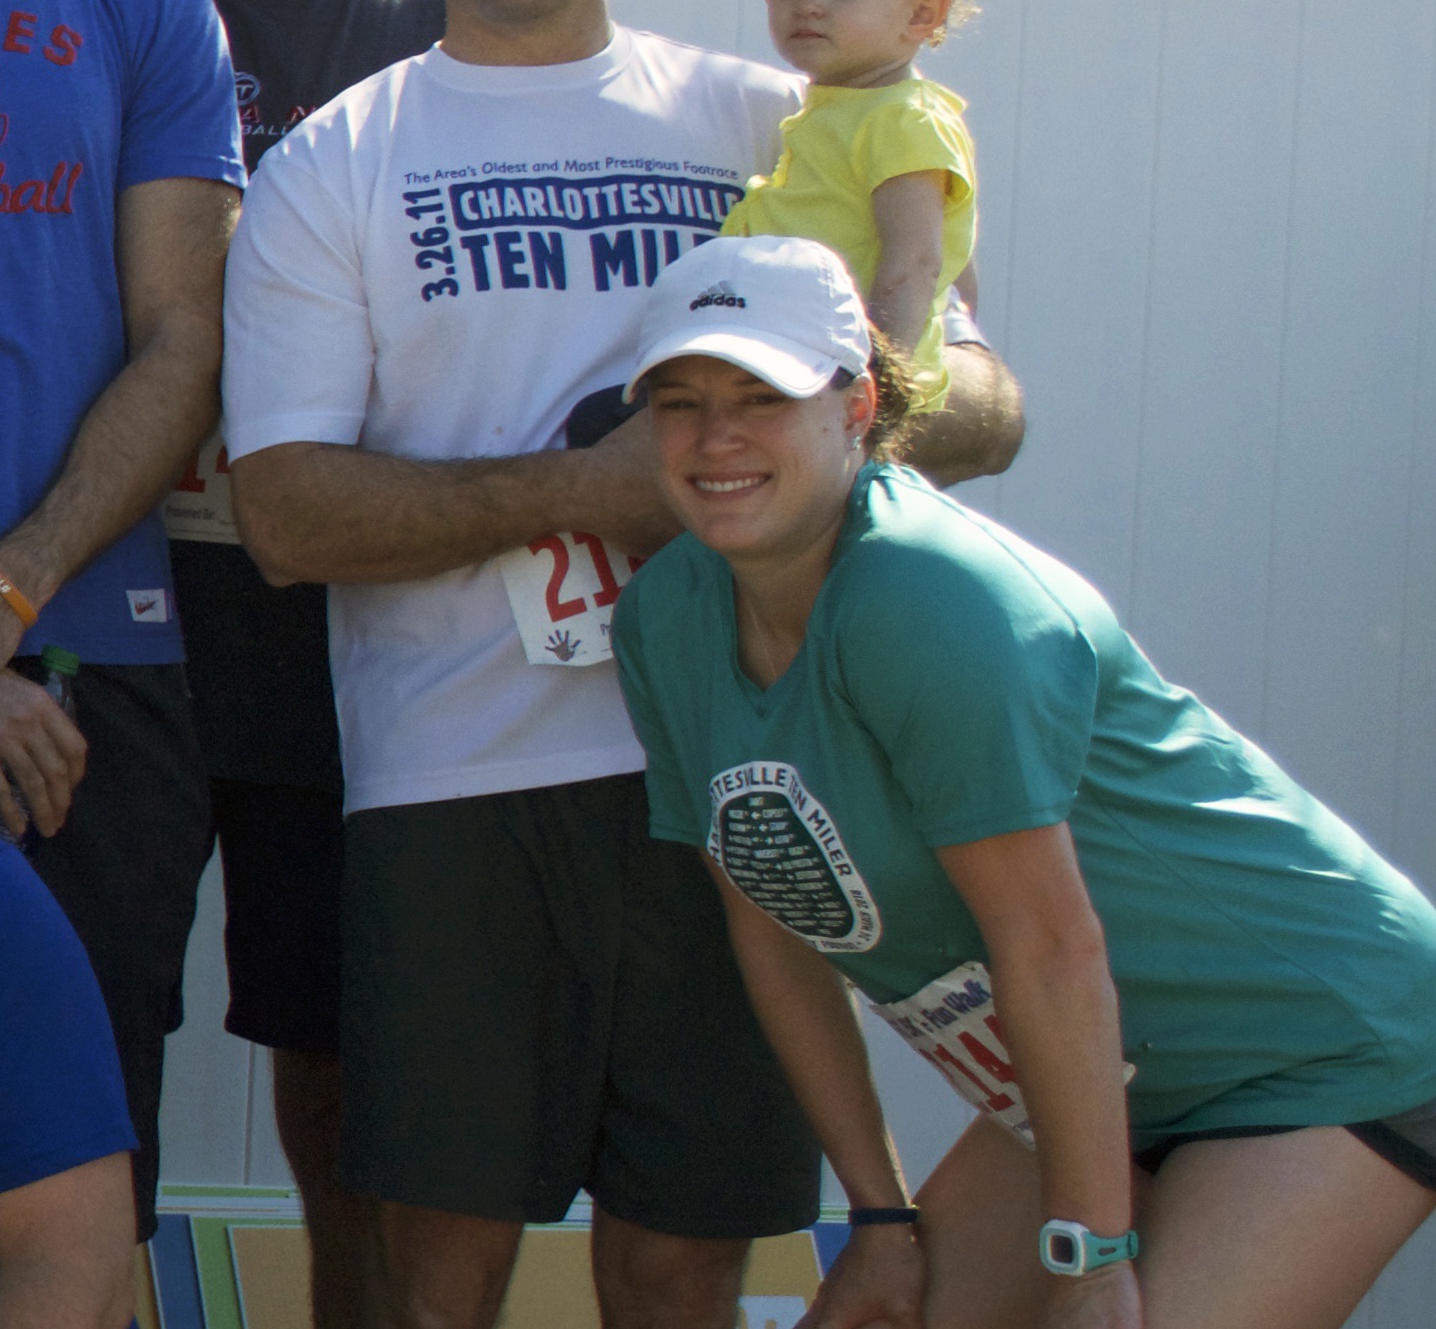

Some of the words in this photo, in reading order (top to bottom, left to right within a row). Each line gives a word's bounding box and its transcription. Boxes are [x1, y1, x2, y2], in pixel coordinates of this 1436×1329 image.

[404, 172, 431, 185] The
[434, 165, 477, 181] Area's
[482, 161, 527, 175] Oldest
[532, 159, 559, 173] and
[564, 159, 601, 172] Most
[605, 156, 679, 172] Prestigious
[683, 160, 739, 181] Footrace
[459, 231, 567, 292] TEN
[689, 293, 746, 311] adidas
